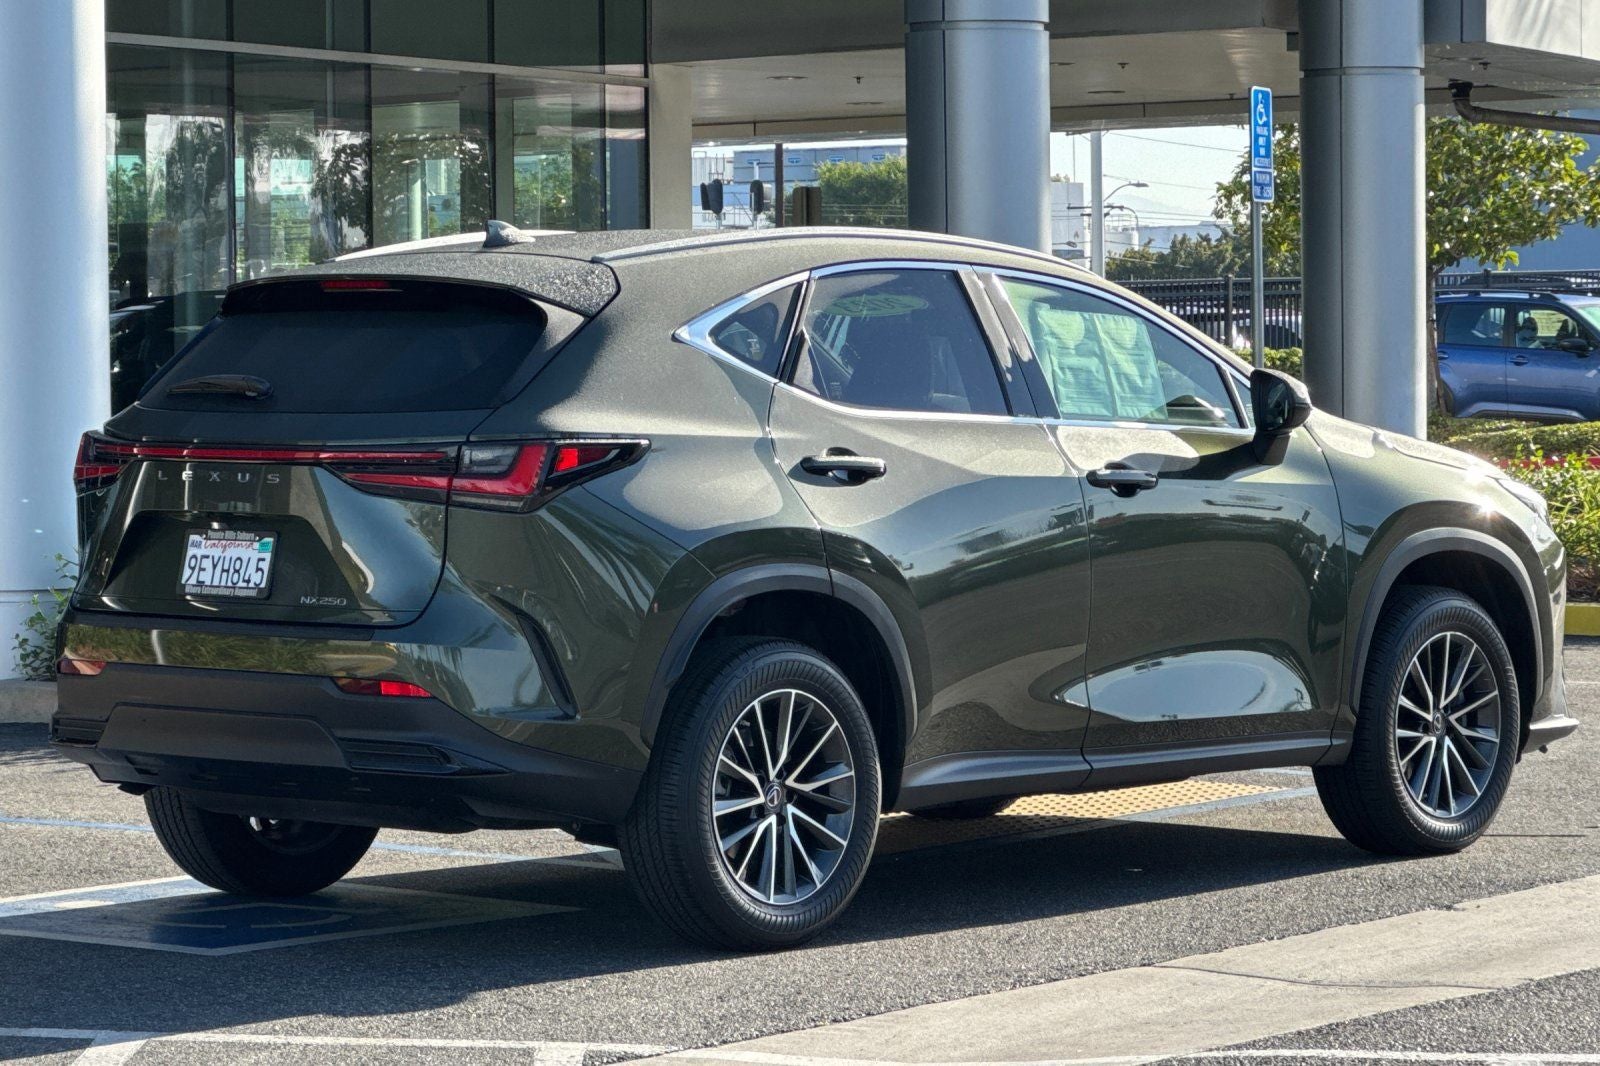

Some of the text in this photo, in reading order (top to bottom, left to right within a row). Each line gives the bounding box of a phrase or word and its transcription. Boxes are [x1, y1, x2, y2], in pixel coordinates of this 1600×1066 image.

[158, 470, 280, 484] LEXUS
[189, 541, 202, 549] MAR
[204, 540, 254, 553] California
[185, 554, 265, 587] 9EYH845
[300, 595, 347, 606] NX250
